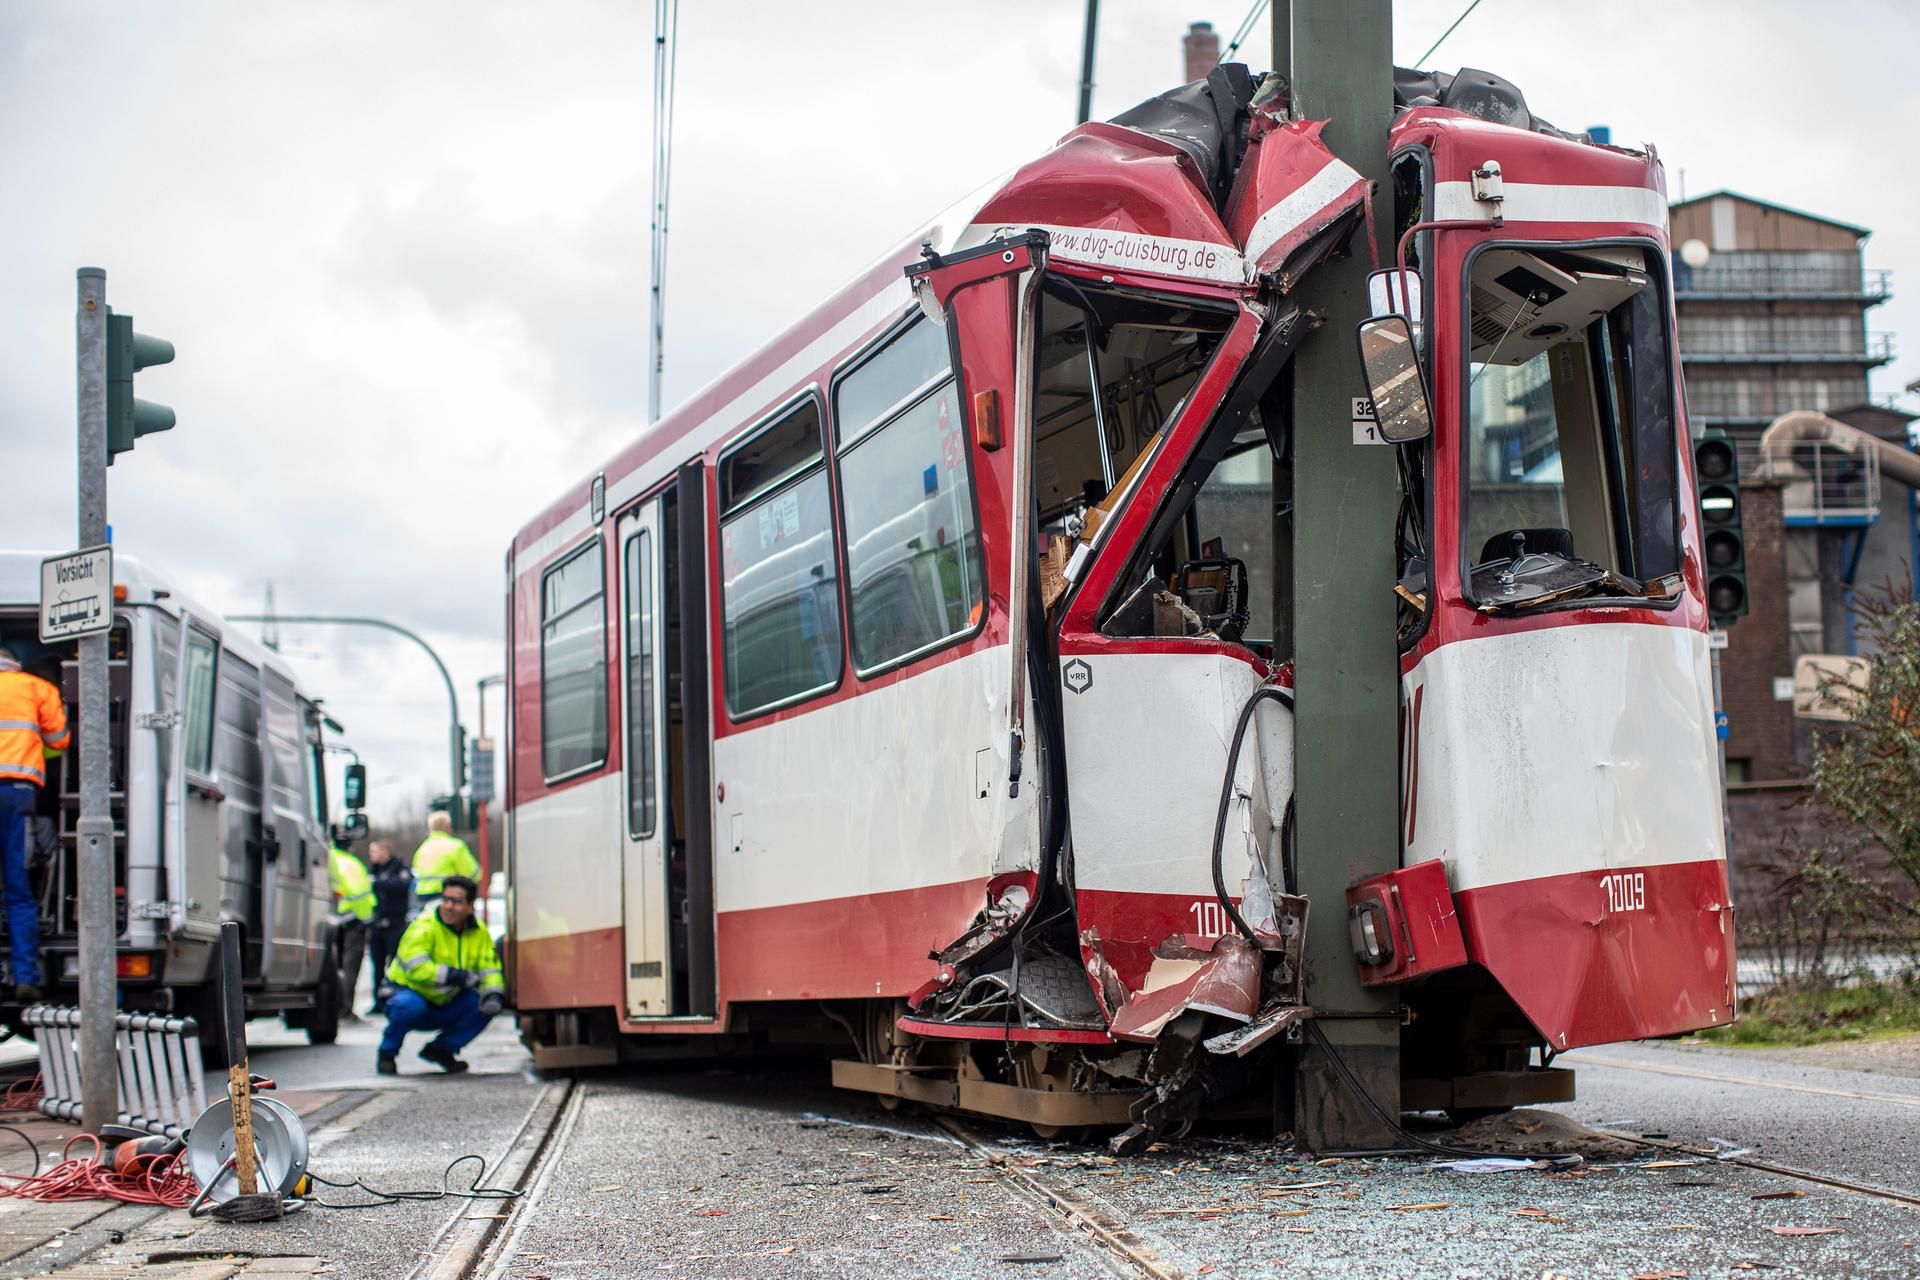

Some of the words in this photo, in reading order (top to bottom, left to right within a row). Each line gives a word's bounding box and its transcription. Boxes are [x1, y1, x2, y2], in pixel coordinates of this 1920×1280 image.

[1050, 230, 1217, 271] ww.dvg-duisburg.de
[1365, 427, 1375, 440] 1
[56, 558, 93, 585] Vorsicht
[1599, 872, 1645, 913] 1009
[1189, 901, 1242, 938] 100
